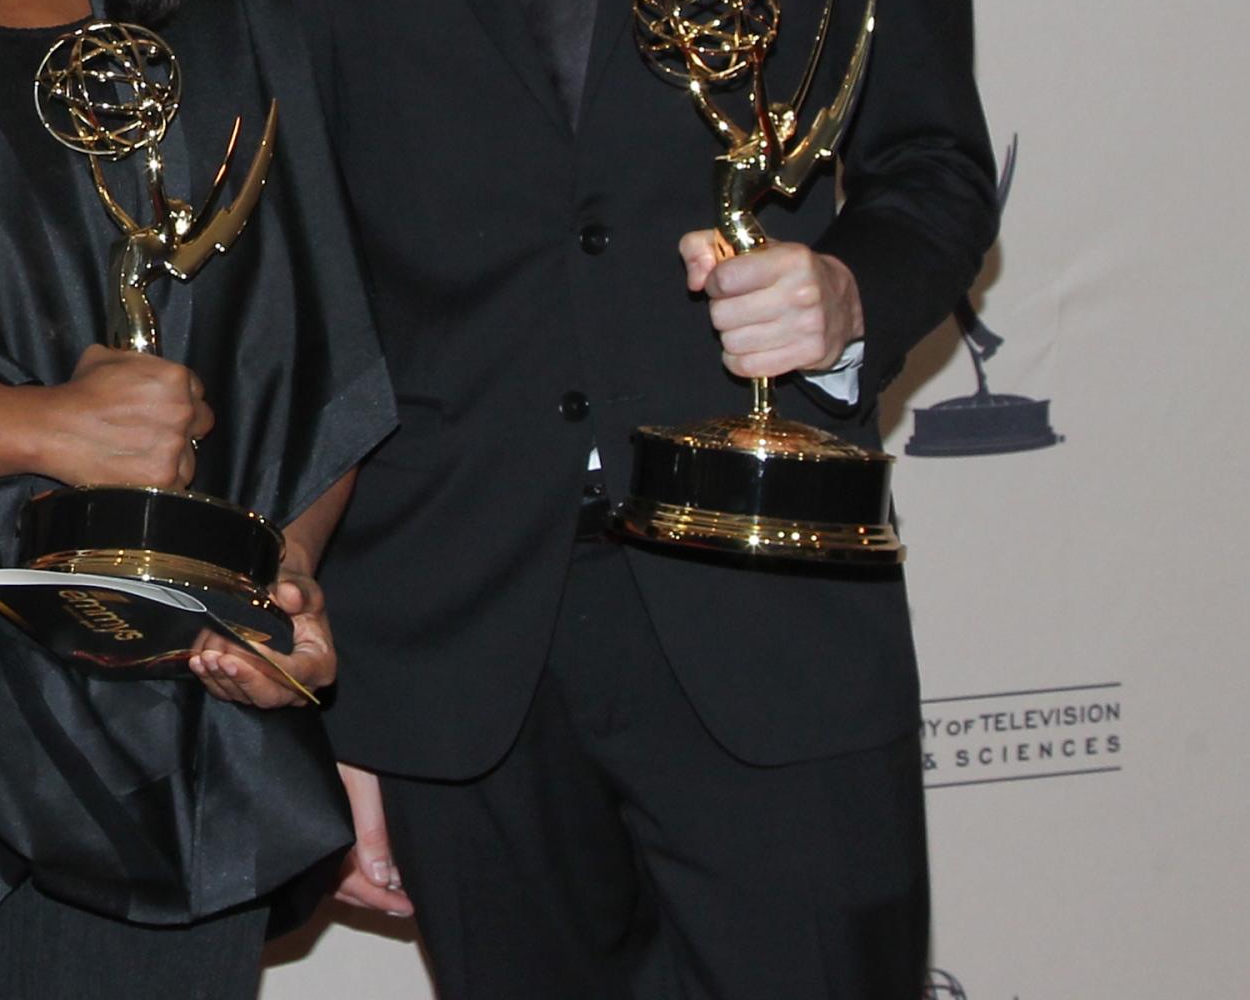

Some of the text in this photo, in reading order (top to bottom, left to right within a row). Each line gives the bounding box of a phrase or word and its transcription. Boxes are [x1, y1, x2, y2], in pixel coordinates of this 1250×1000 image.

[920, 703, 1121, 738] Y OF TELEVISION
[921, 735, 1121, 770] & SCIENCES
